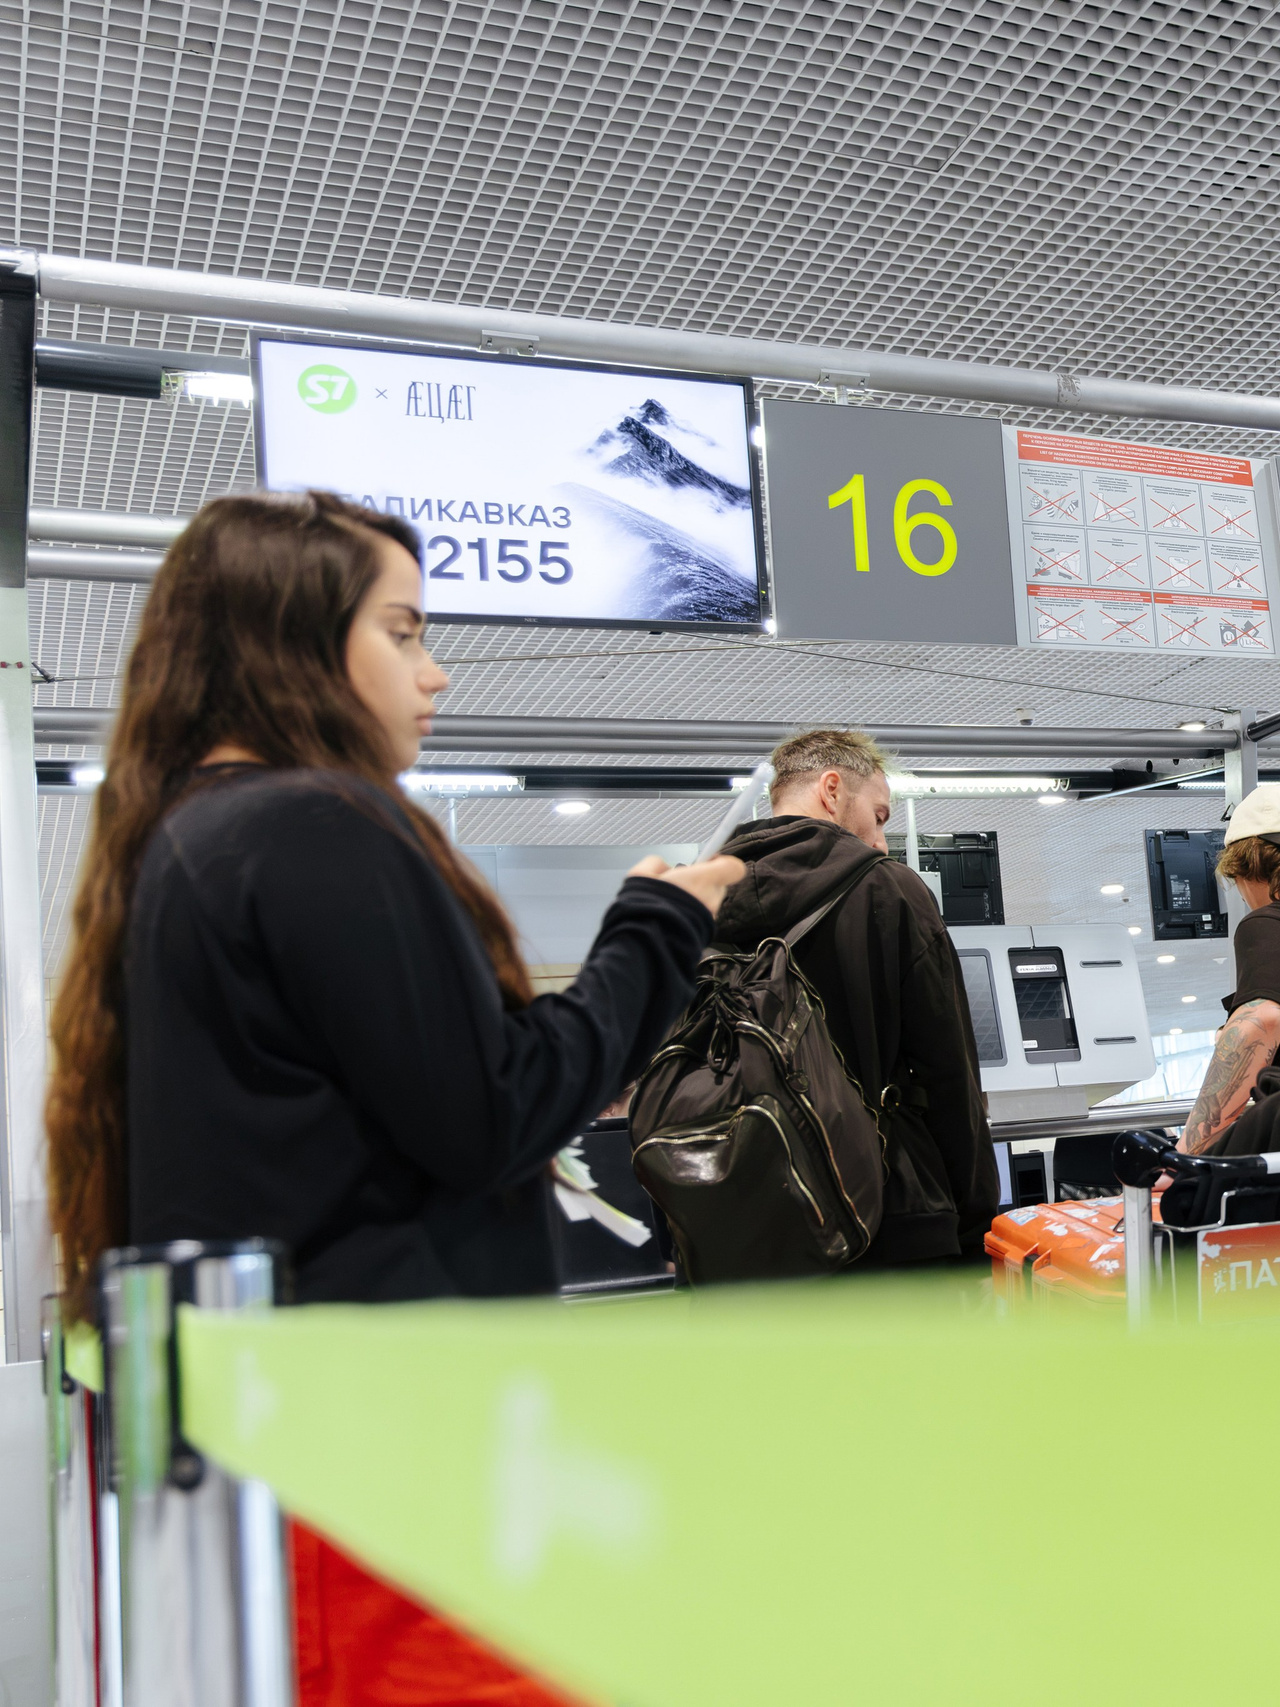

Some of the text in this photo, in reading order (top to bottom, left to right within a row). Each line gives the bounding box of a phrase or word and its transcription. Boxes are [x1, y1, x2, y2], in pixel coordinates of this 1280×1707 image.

[304, 375, 350, 405] S7
[339, 493, 573, 529] АДИКАВКАЗ
[828, 473, 959, 577] 16
[426, 534, 574, 585] 2155
